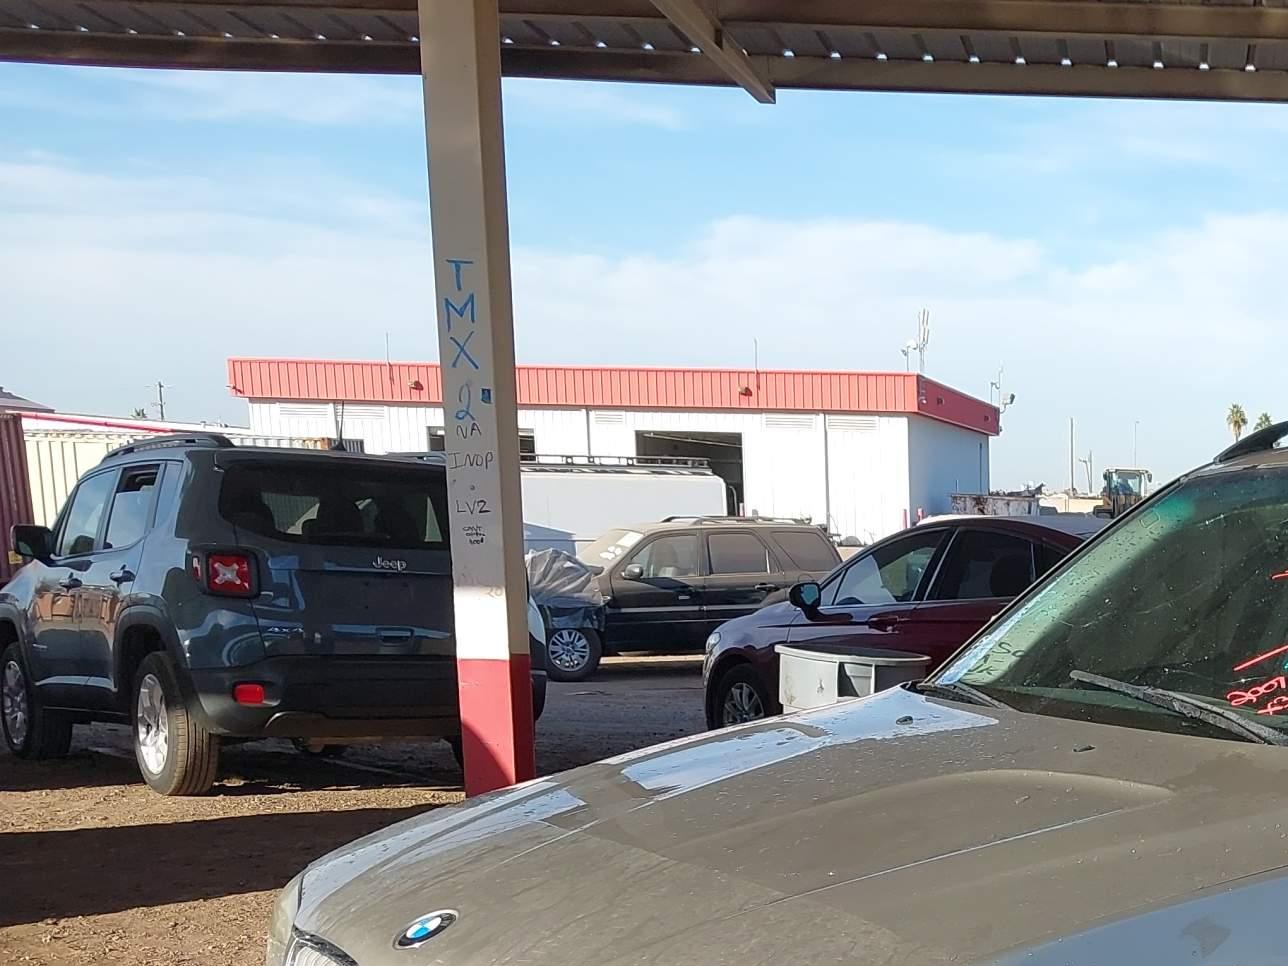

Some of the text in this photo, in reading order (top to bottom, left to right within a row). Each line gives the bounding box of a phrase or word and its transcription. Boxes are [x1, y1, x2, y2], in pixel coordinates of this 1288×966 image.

[444, 259, 480, 370] TMX
[456, 422, 482, 439] NA
[448, 451, 494, 470] INOP
[456, 499, 491, 515] LV2
[372, 556, 407, 572] Jeep
